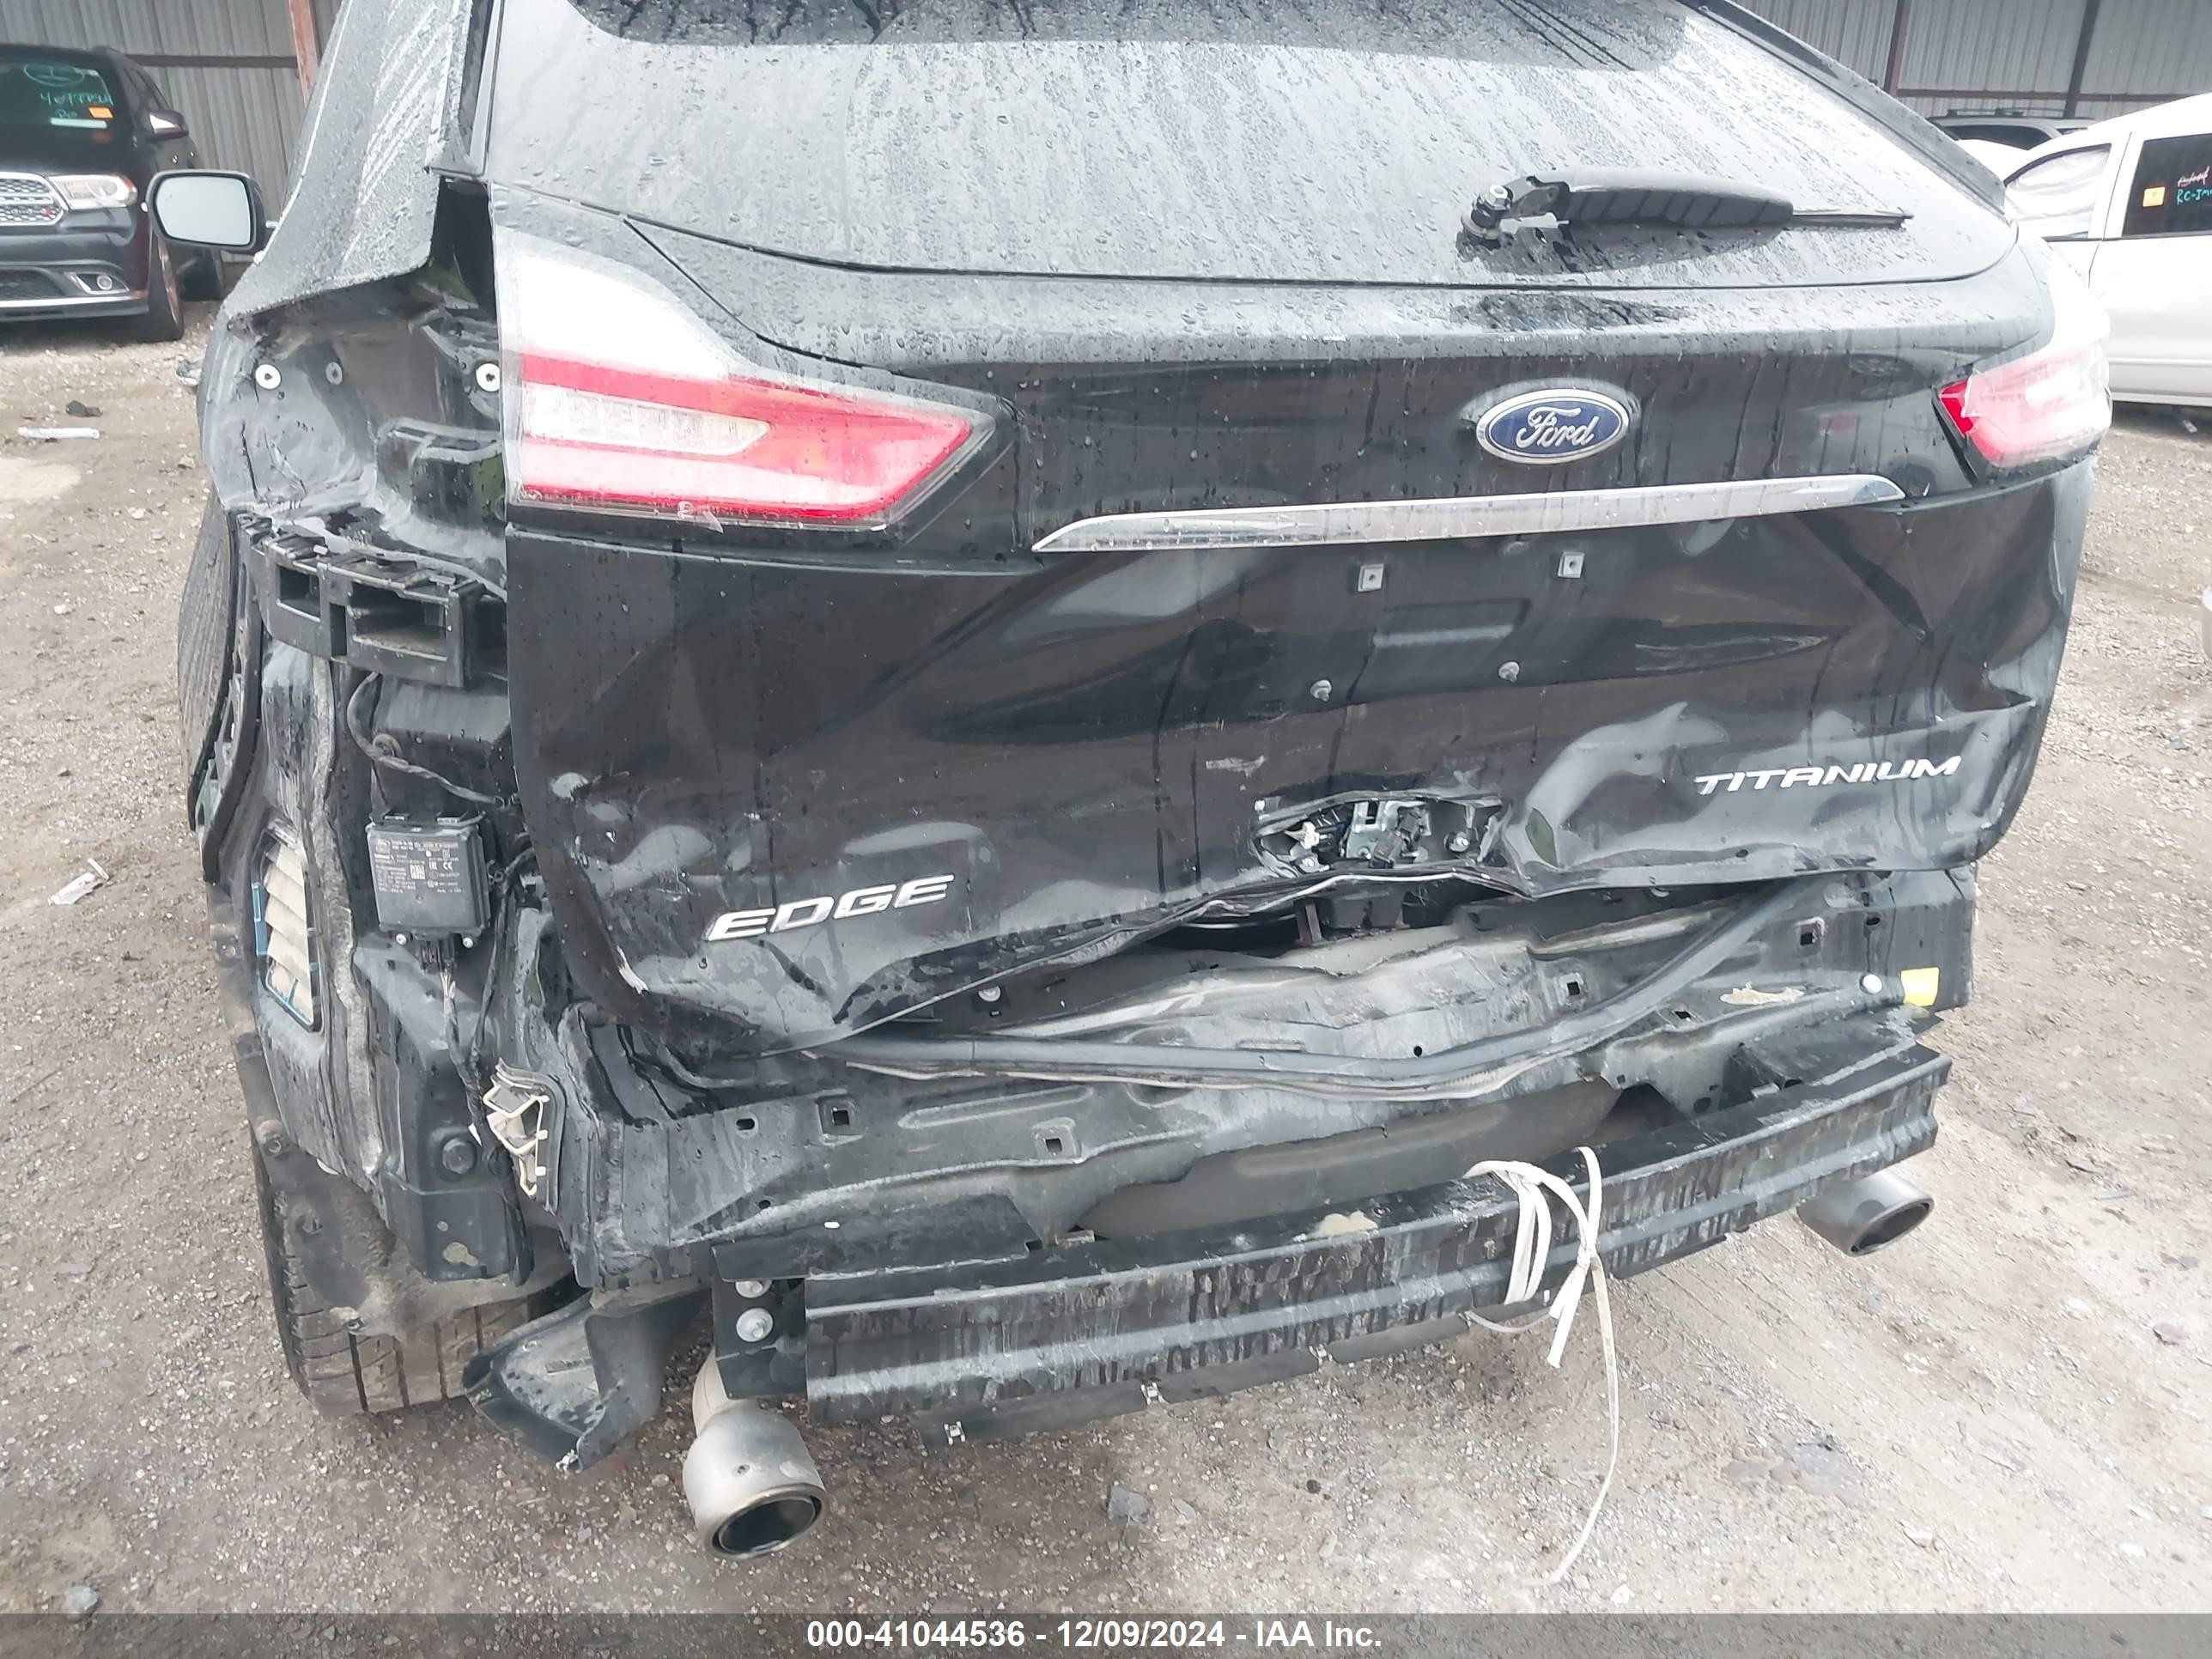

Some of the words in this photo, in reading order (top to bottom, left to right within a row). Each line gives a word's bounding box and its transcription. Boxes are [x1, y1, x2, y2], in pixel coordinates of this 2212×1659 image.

[1516, 406, 1600, 448] Ford
[1693, 755, 1963, 796] TITANIUM
[702, 873, 955, 942] EDGE
